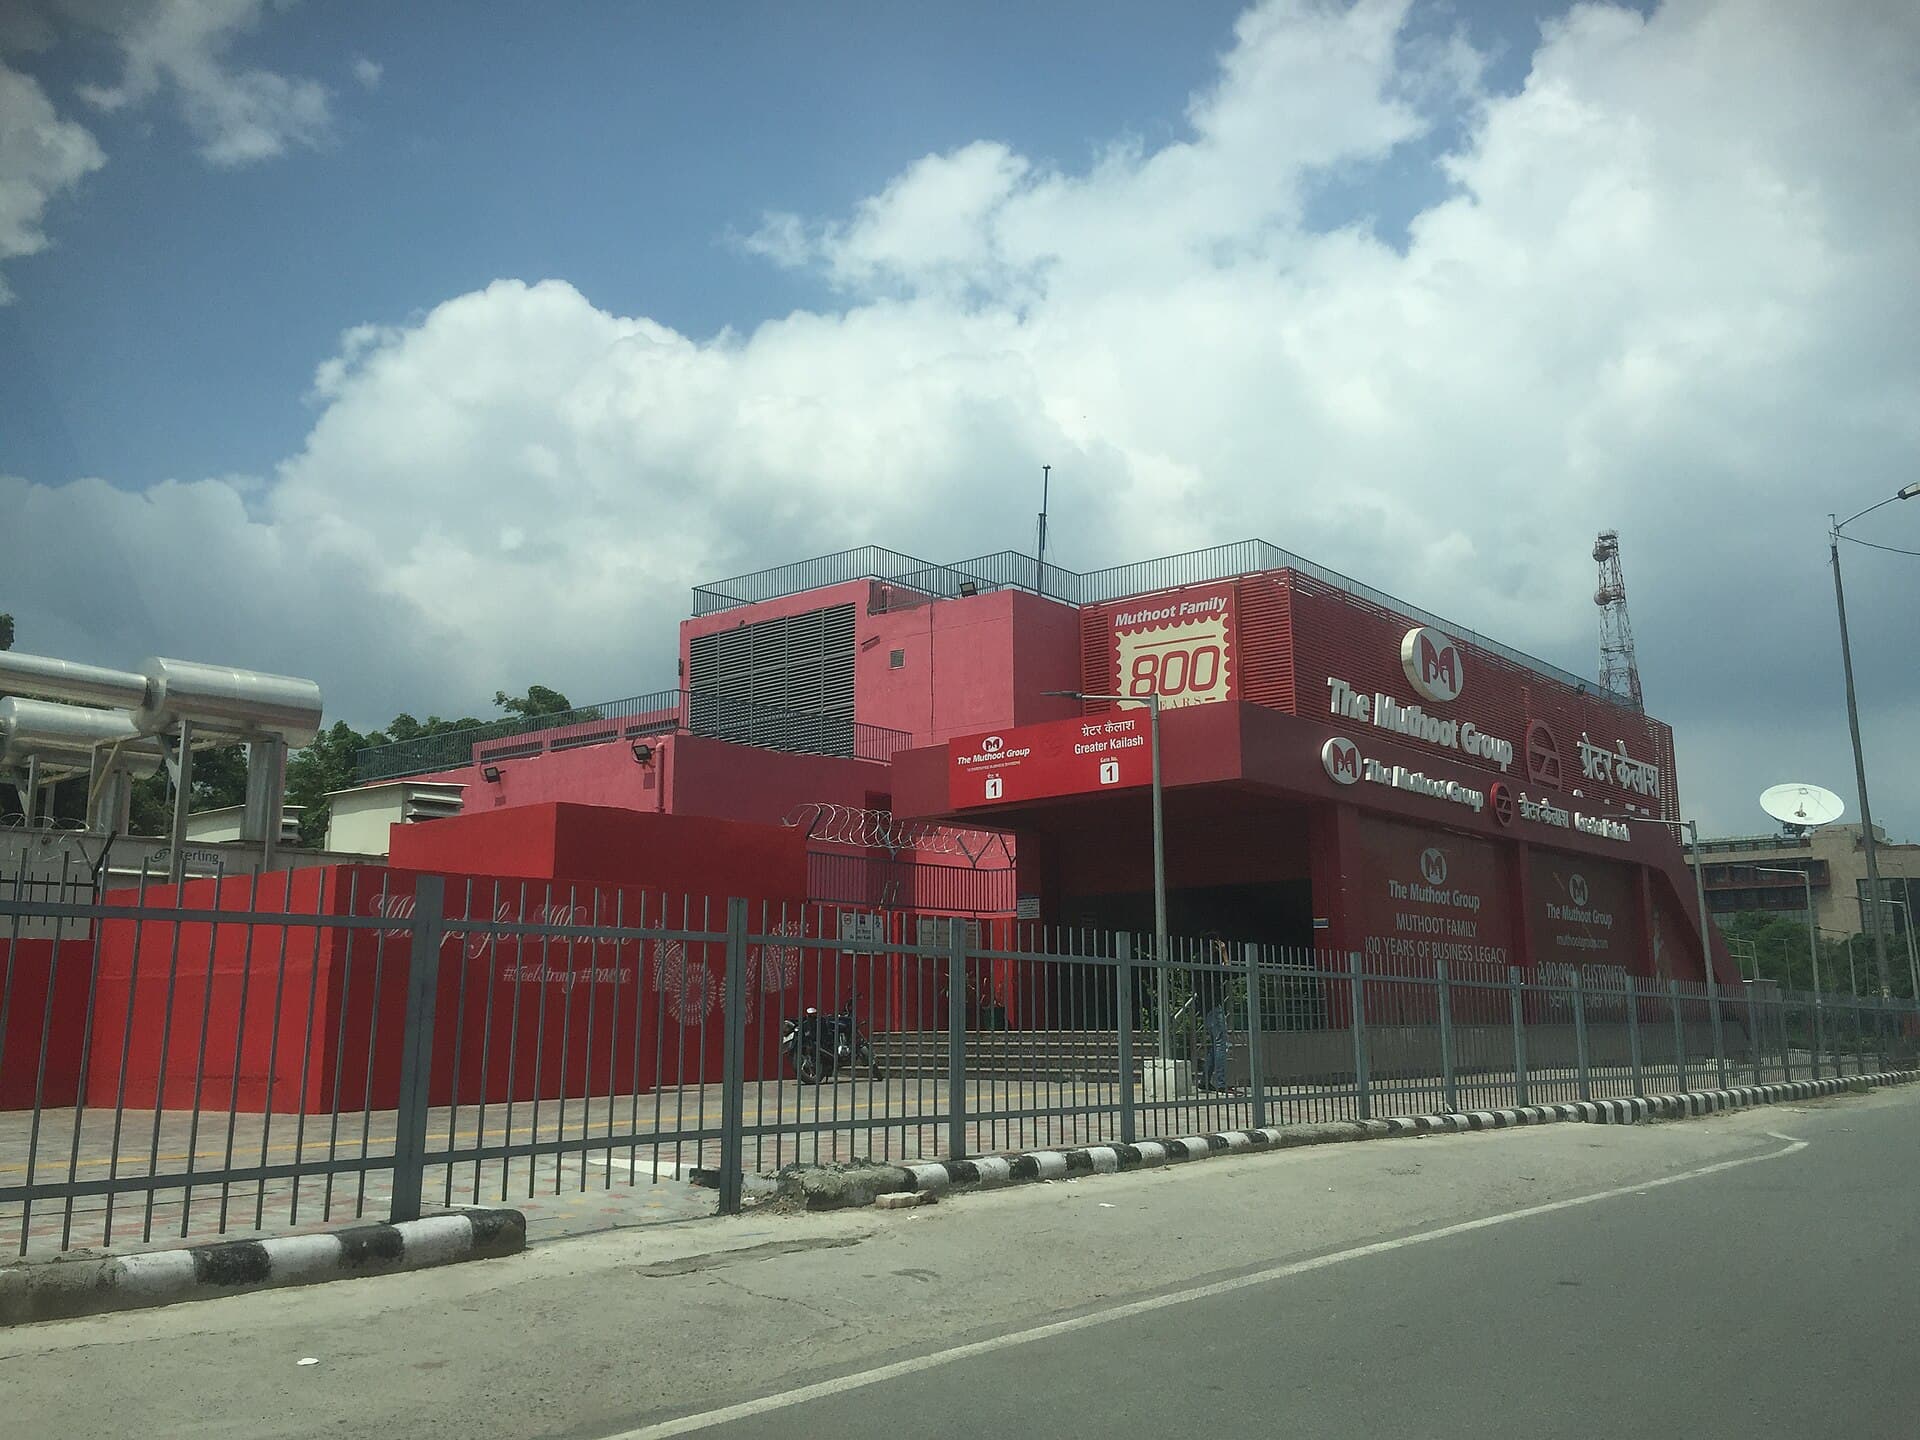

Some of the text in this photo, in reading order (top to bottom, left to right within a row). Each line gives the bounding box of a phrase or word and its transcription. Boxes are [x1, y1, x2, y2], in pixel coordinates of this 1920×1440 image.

[1114, 596, 1228, 627] Muthoot Family
[1129, 645, 1221, 697] 800
[1103, 720, 1136, 734] कैलाश
[1327, 677, 1513, 772] The Muthoot Group
[957, 748, 1030, 765] The Muthoot Group
[1074, 735, 1144, 755] Greater Kailash
[1105, 765, 1114, 782] 1
[1363, 757, 1392, 785] The
[1446, 780, 1484, 813] Group
[990, 780, 998, 797] 1
[179, 850, 219, 865] terling
[1388, 879, 1480, 914] The Muthoot Group
[1395, 912, 1478, 937] MUTHOOT FAMILY
[1546, 903, 1614, 930] The Muthoot Group
[1382, 937, 1416, 957] YEARS
[1417, 941, 1431, 958] OF
[1432, 942, 1473, 962] BUSINESS
[1474, 946, 1507, 964] LEGACY
